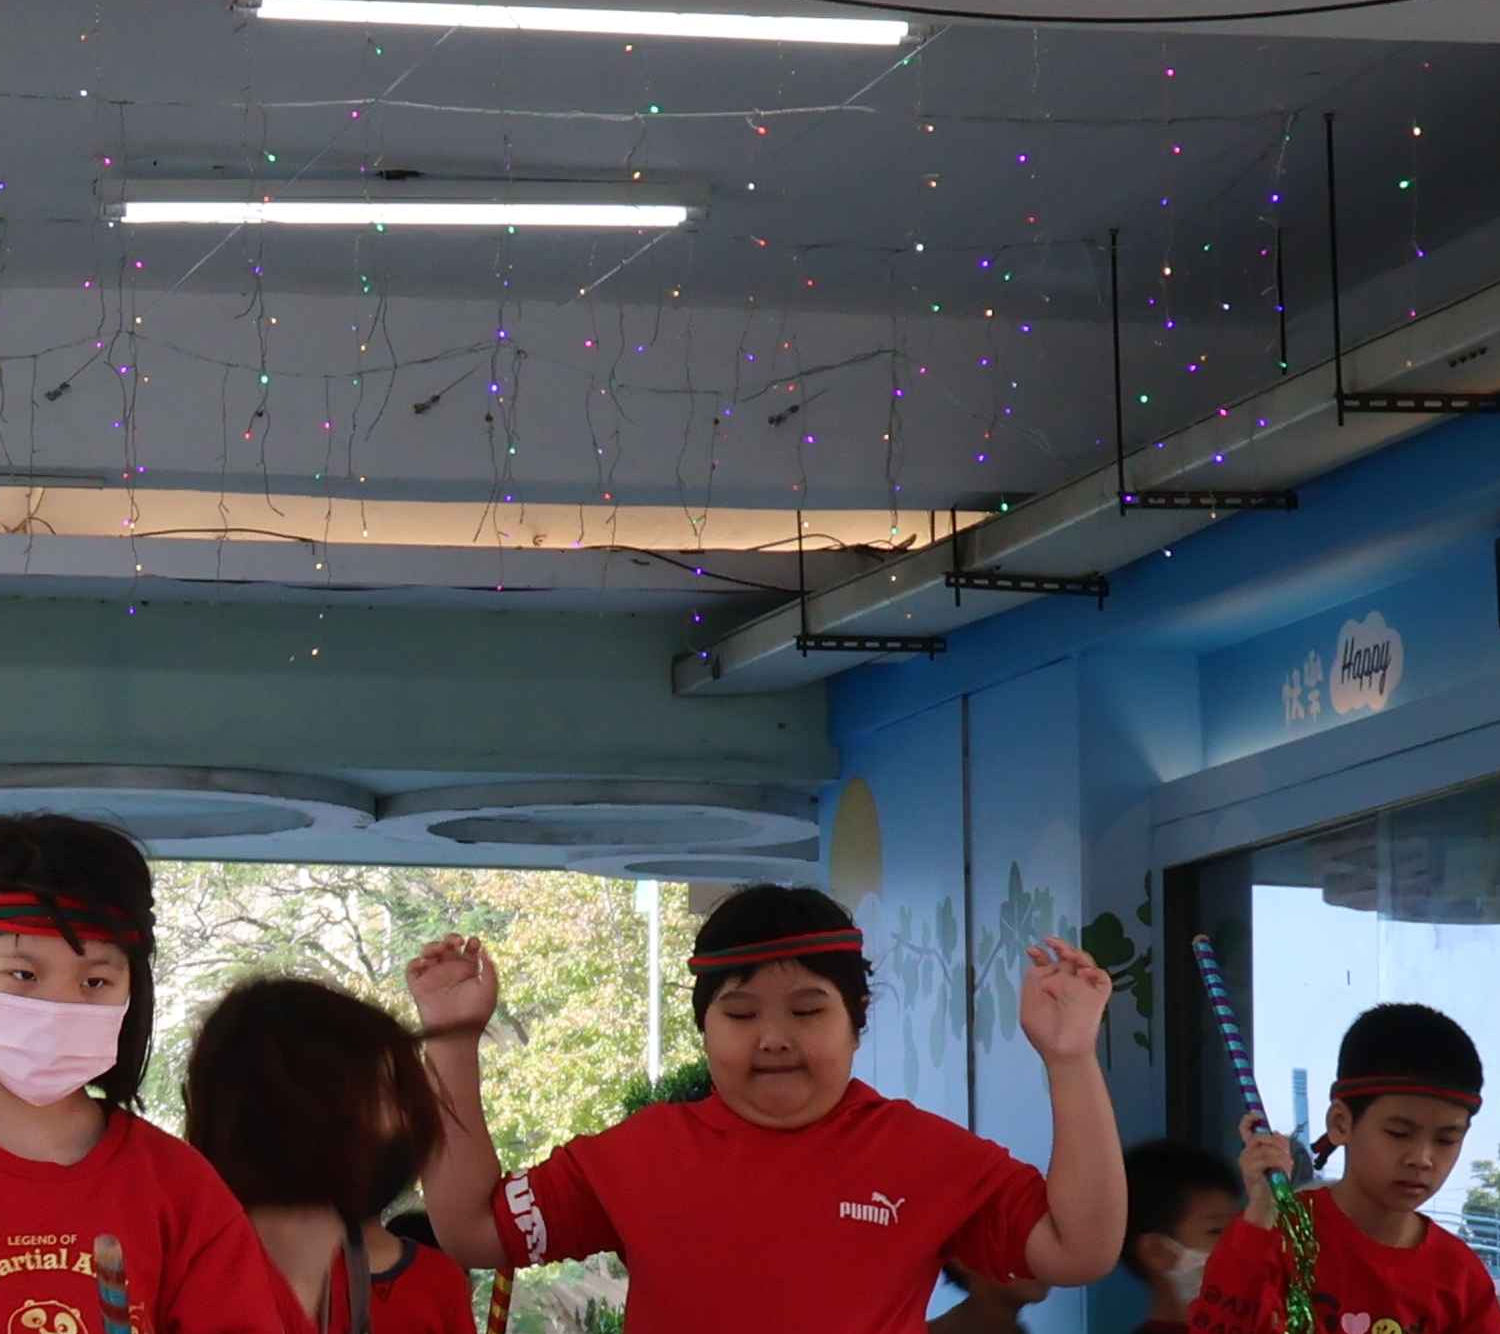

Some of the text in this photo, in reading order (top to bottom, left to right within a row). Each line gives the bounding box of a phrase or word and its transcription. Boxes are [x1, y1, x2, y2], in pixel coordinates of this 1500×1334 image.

[1341, 637, 1392, 696] Happy
[839, 1201, 890, 1227] PUMA
[7, 1234, 78, 1247] LEGEND OF
